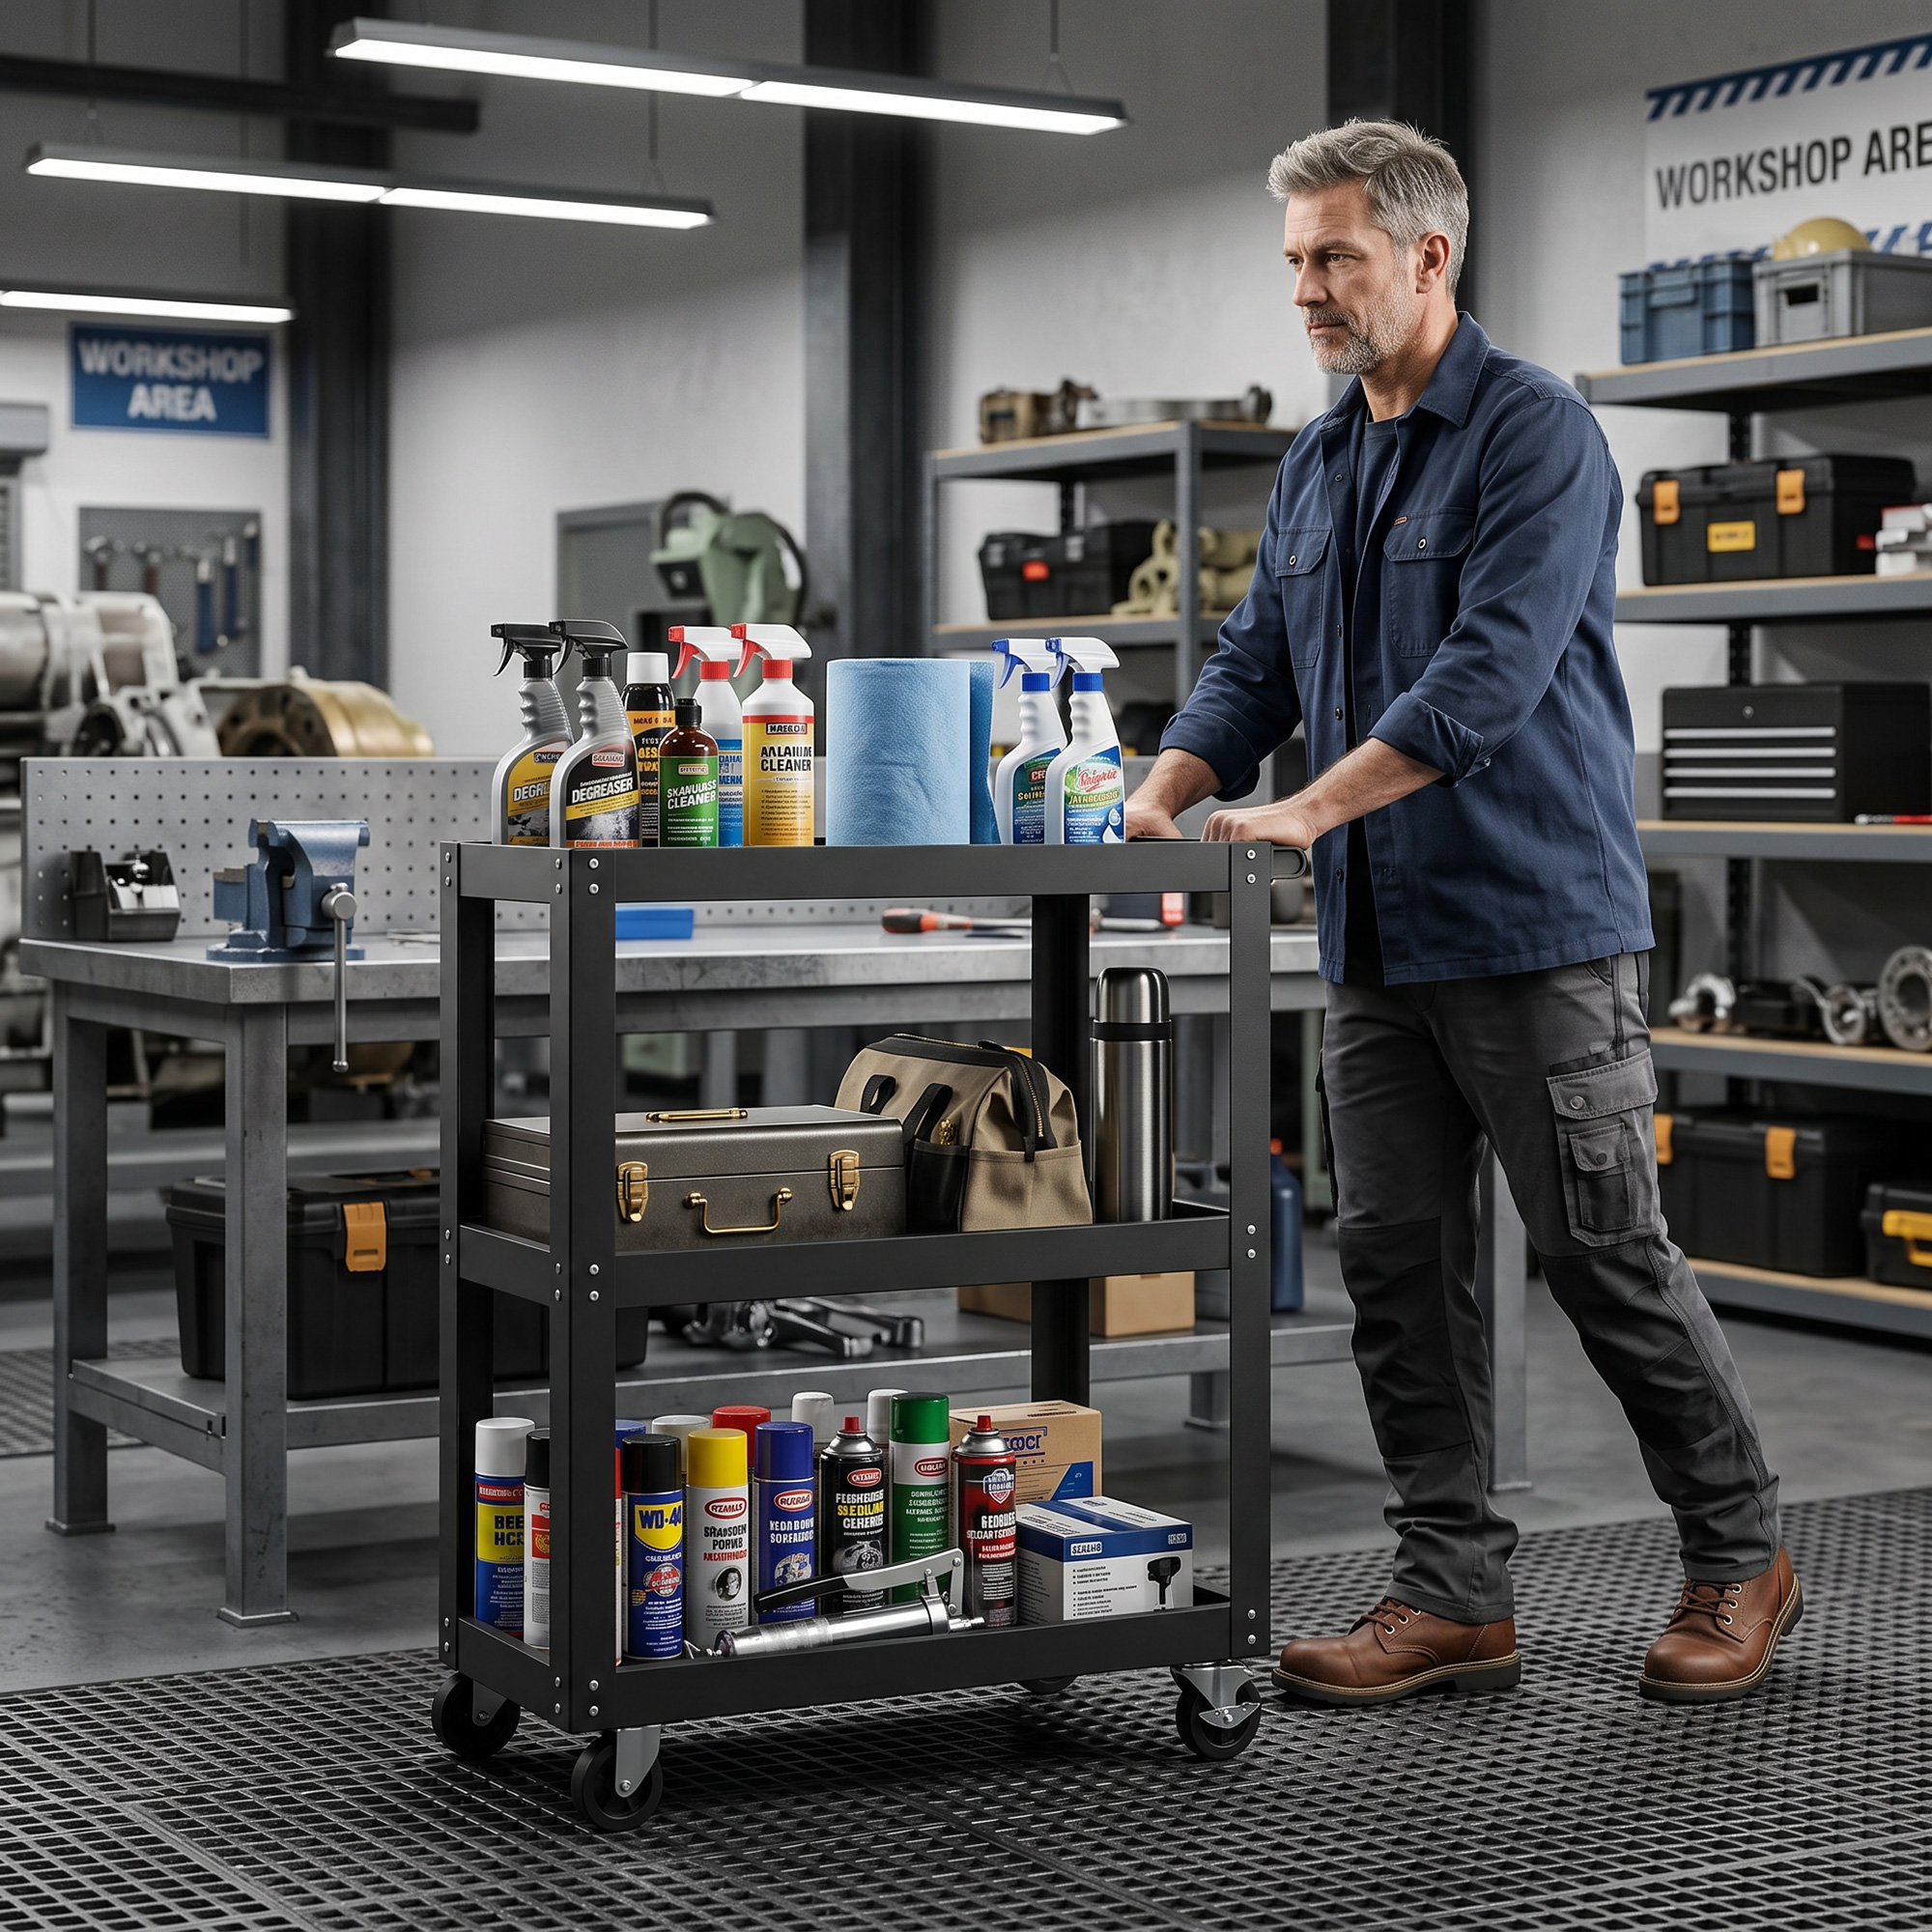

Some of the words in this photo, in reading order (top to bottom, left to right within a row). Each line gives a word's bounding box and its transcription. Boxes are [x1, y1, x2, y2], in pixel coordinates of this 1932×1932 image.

[1656, 134, 1853, 210] WORKSHOP
[77, 340, 263, 384] WORKSHOP
[127, 384, 217, 421] AREA
[760, 759, 811, 772] CLEANER
[572, 777, 634, 805] DEGREASER
